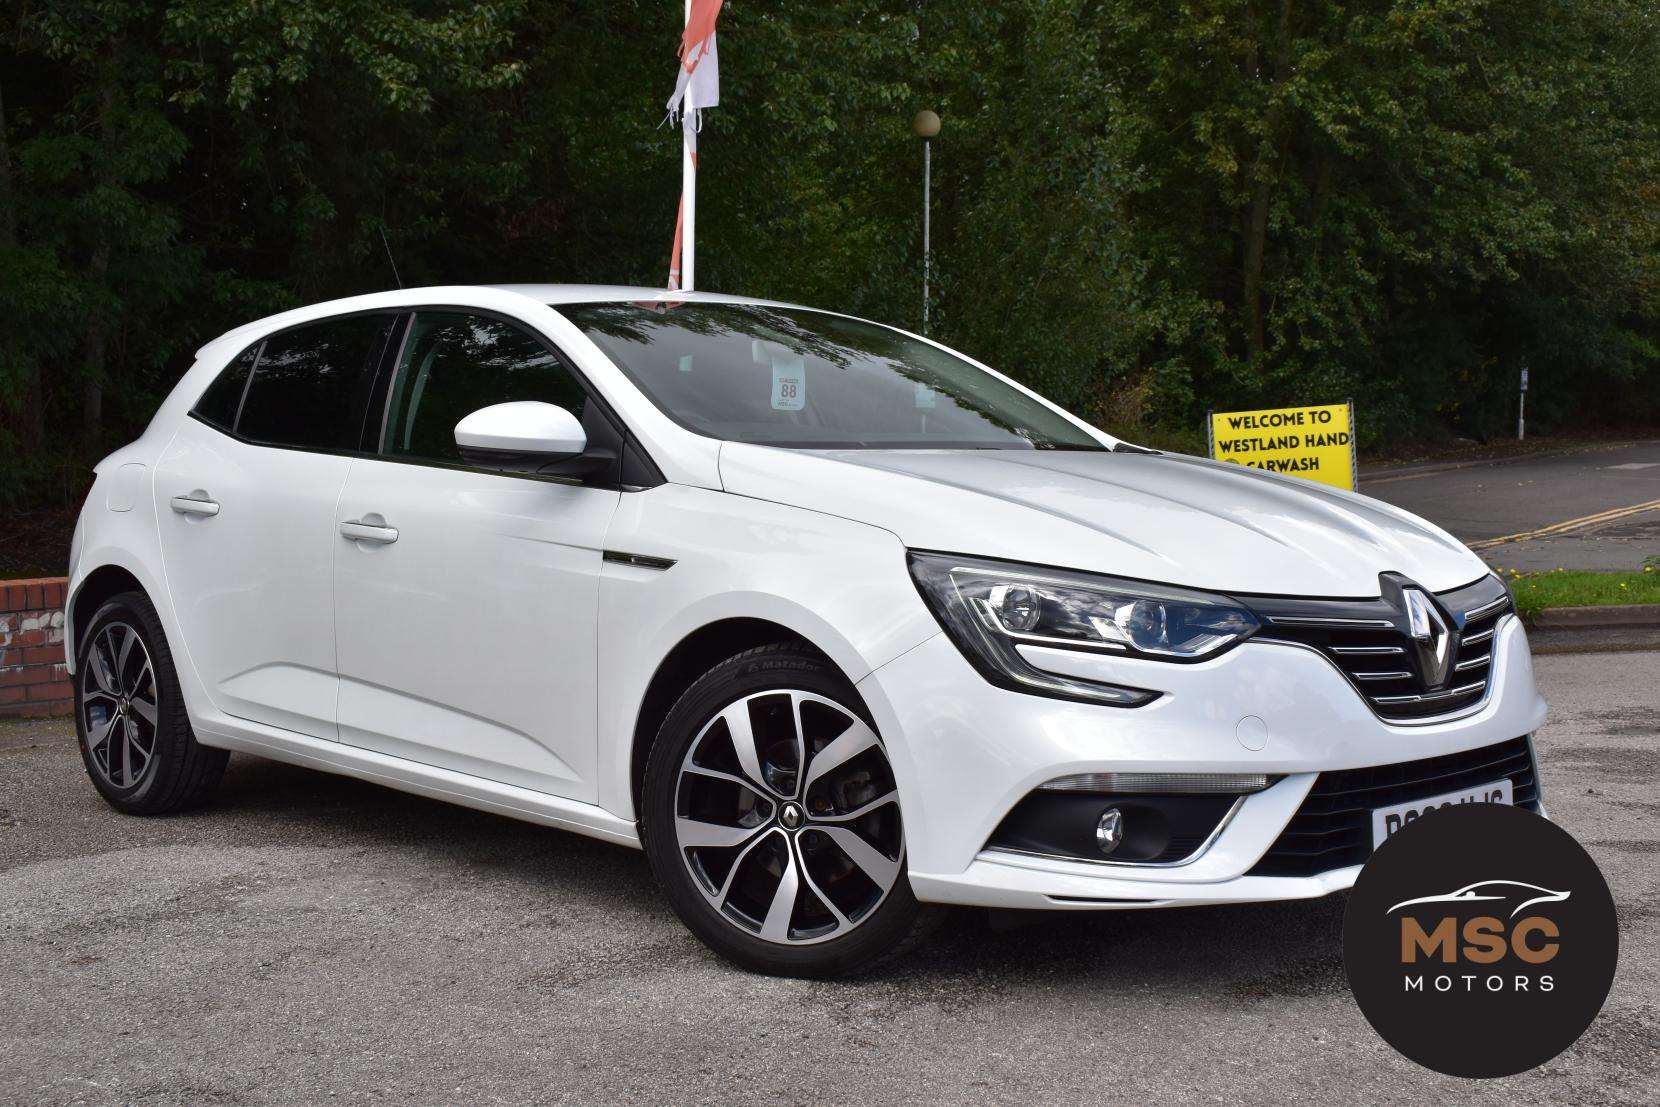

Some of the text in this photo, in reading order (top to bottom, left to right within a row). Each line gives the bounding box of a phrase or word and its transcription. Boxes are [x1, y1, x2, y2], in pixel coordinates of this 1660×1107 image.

[781, 384, 797, 398] 88
[1228, 410, 1331, 430] WELCOME TO
[1218, 432, 1349, 453] WESTLAND HAND
